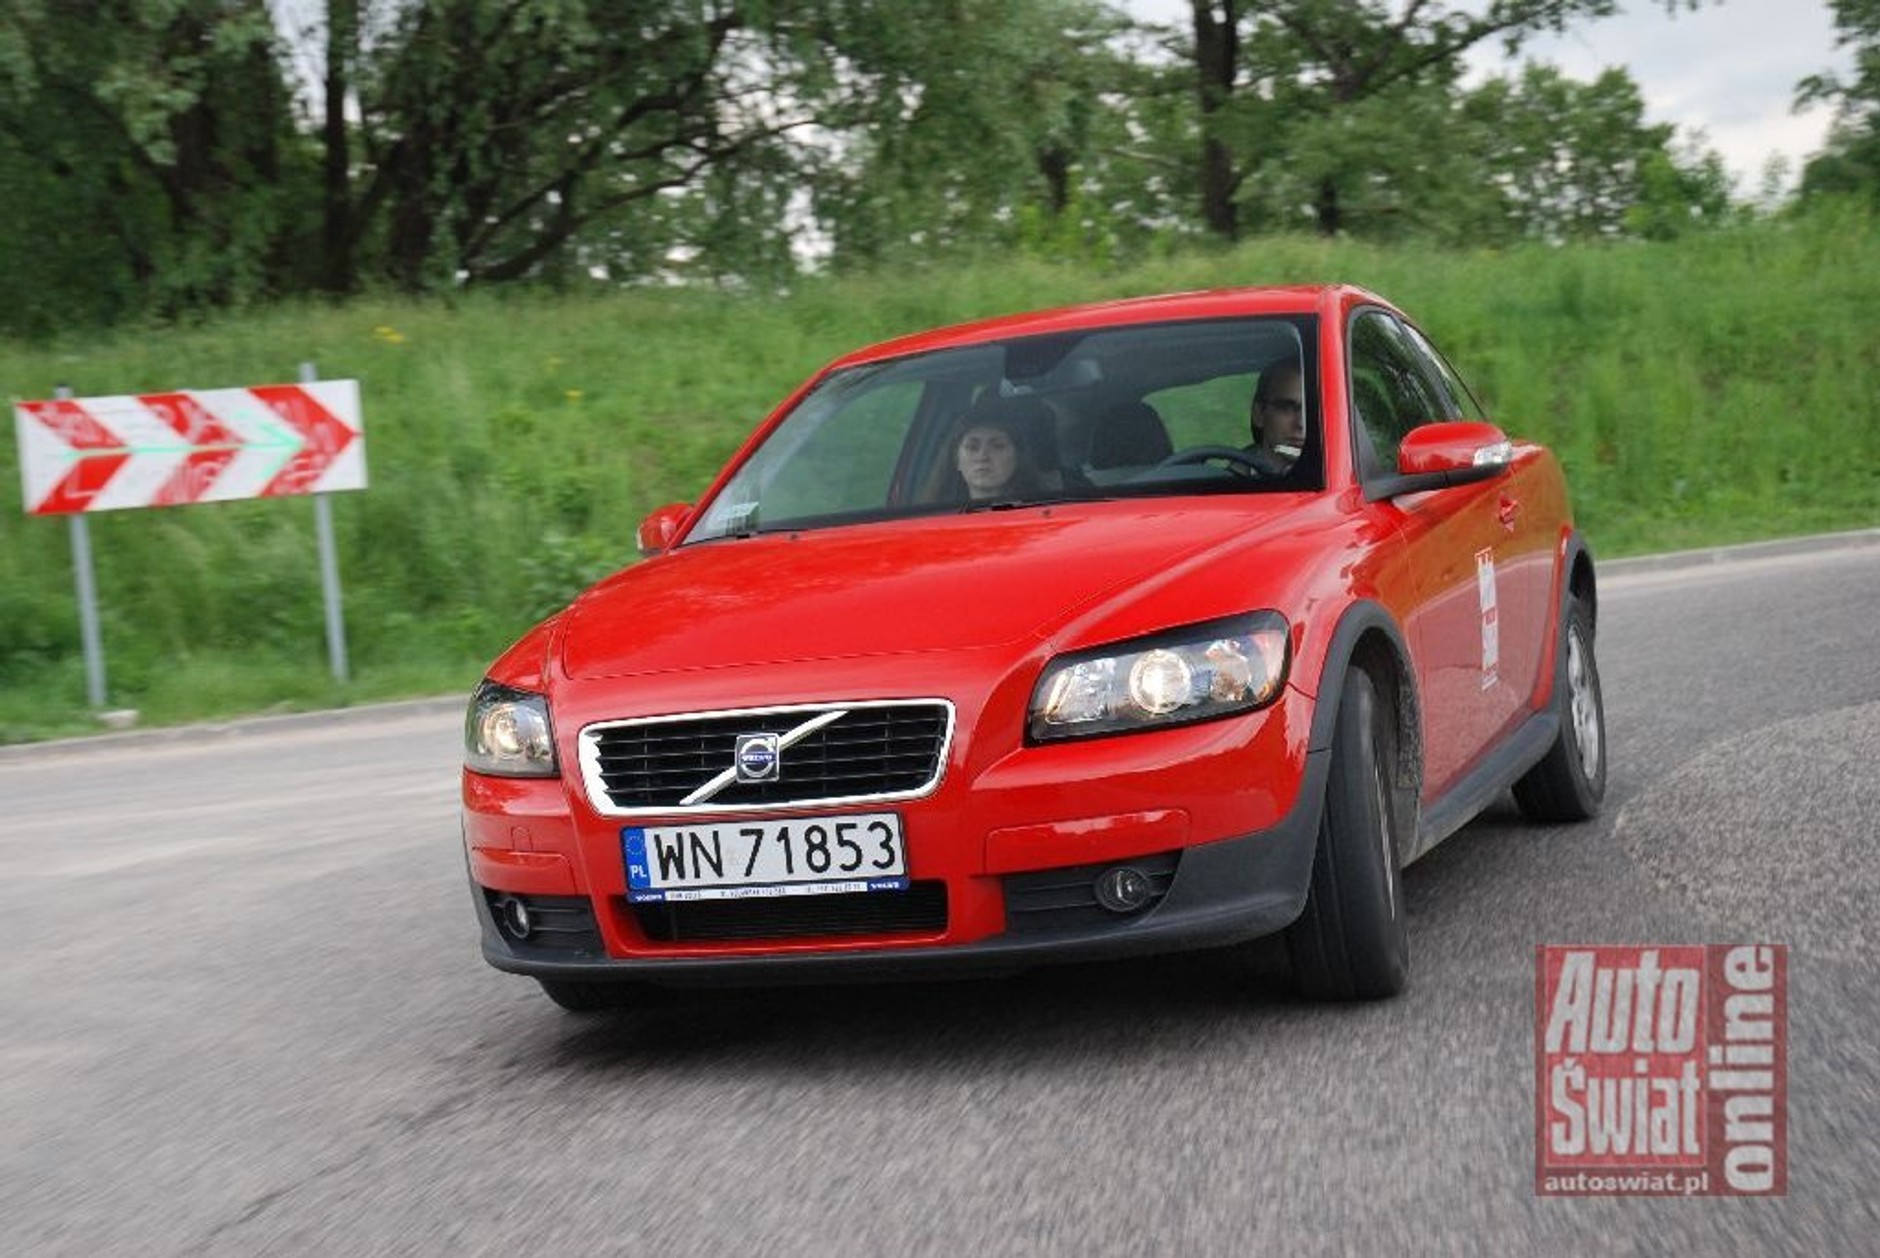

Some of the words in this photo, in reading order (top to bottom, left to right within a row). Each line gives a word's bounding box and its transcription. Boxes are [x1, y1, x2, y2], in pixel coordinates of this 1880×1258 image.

[654, 829, 724, 881] WN
[740, 821, 896, 877] 71853
[630, 865, 648, 879] PL
